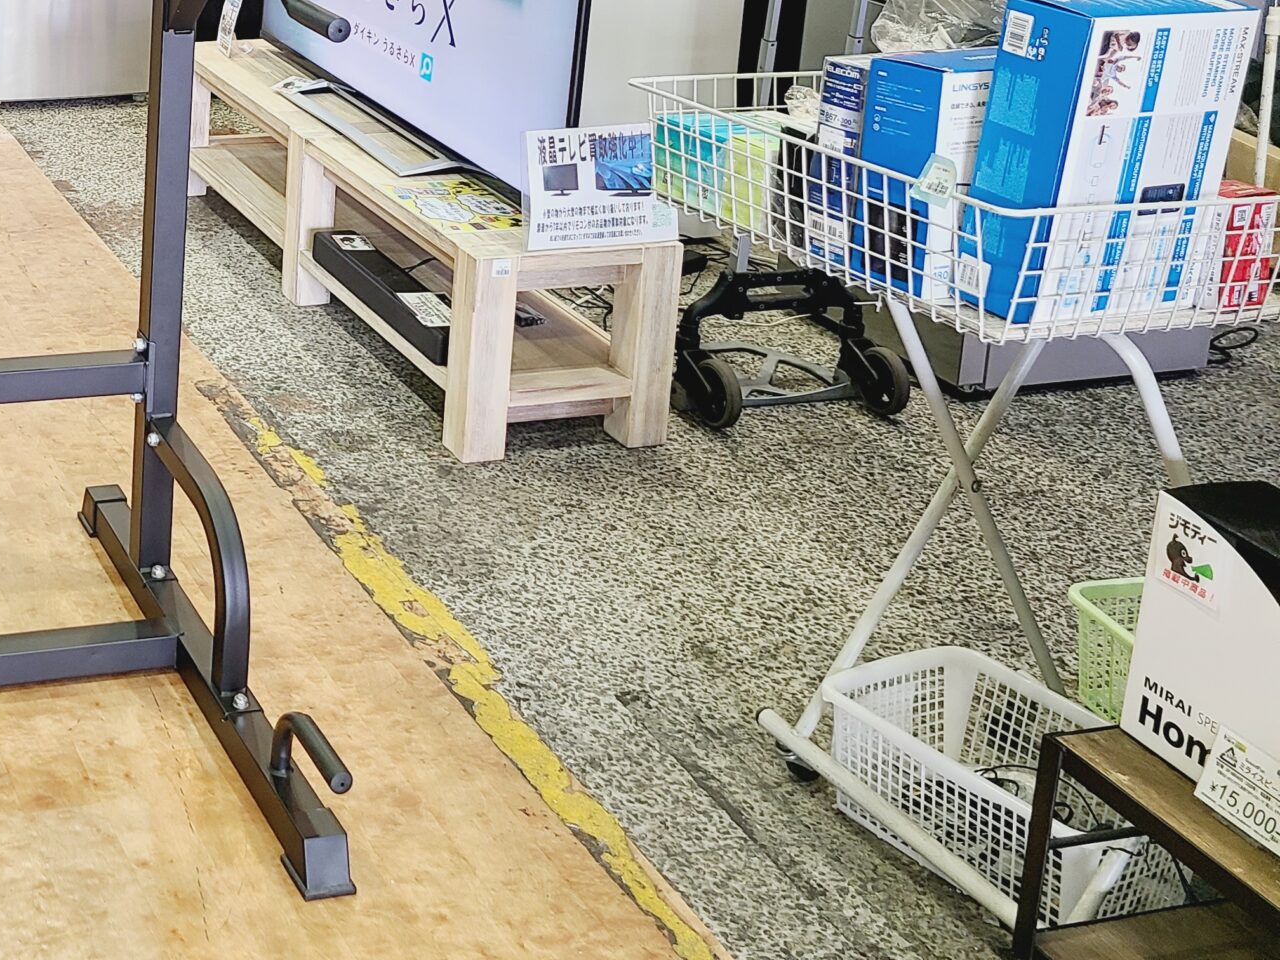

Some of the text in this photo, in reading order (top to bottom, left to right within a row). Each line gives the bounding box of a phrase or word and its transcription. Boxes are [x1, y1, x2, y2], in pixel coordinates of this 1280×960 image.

[353, 22, 416, 68] ダイキン うるさらX
[1202, 29, 1221, 97] LESS BUFFERING
[1211, 28, 1227, 87] MORE GAMING
[1214, 28, 1234, 102] MORE STREAMING
[1229, 27, 1250, 94] MAX-STREAM
[1114, 218, 1127, 260] MAX-SREAM
[1169, 512, 1218, 545] ジモティー
[1144, 675, 1192, 717] MIRAI
